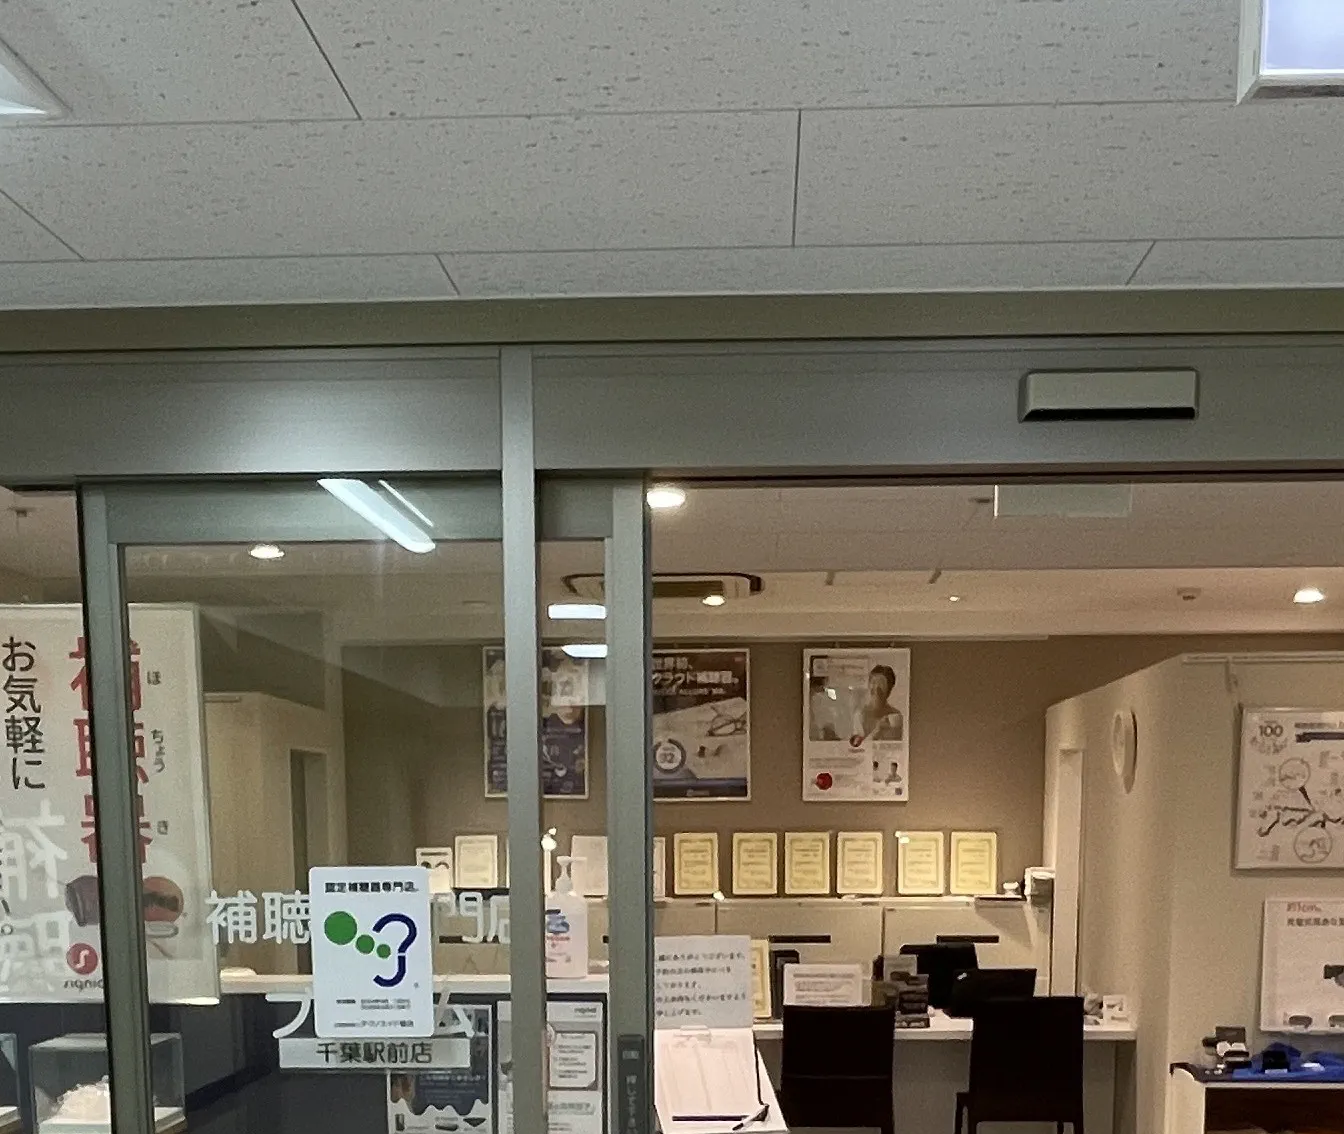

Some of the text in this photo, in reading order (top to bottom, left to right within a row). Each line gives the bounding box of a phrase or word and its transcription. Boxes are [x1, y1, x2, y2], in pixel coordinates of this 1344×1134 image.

[1, 635, 45, 790] お気軽に
[316, 1041, 433, 1065] 千葉駅前店
